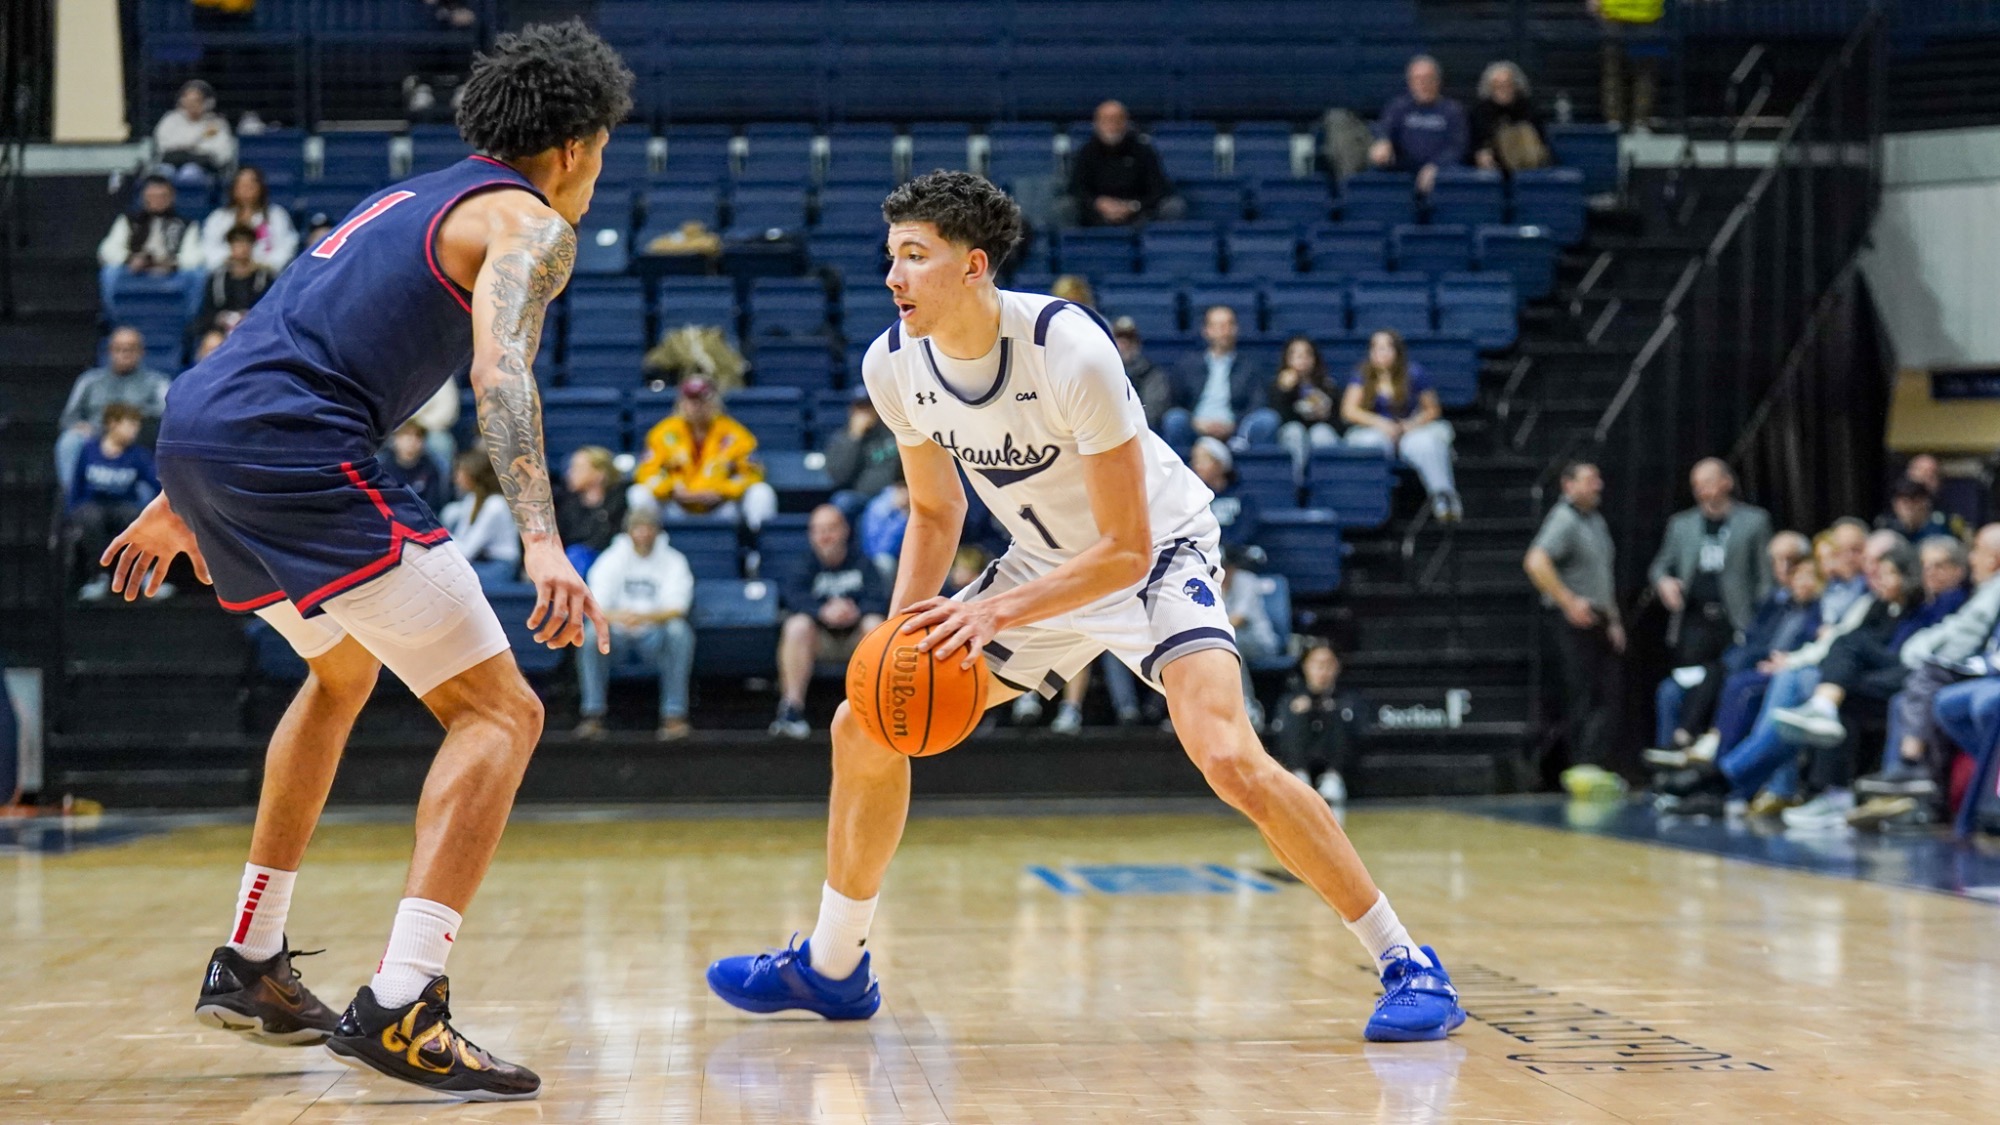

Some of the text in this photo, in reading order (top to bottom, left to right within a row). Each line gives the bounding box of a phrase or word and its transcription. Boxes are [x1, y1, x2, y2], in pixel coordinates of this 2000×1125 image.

[311, 190, 416, 259] 1
[1015, 391, 1038, 401] CAA
[933, 430, 1060, 468] Hawks
[1017, 503, 1063, 549] 1
[892, 645, 919, 737] Wilson
